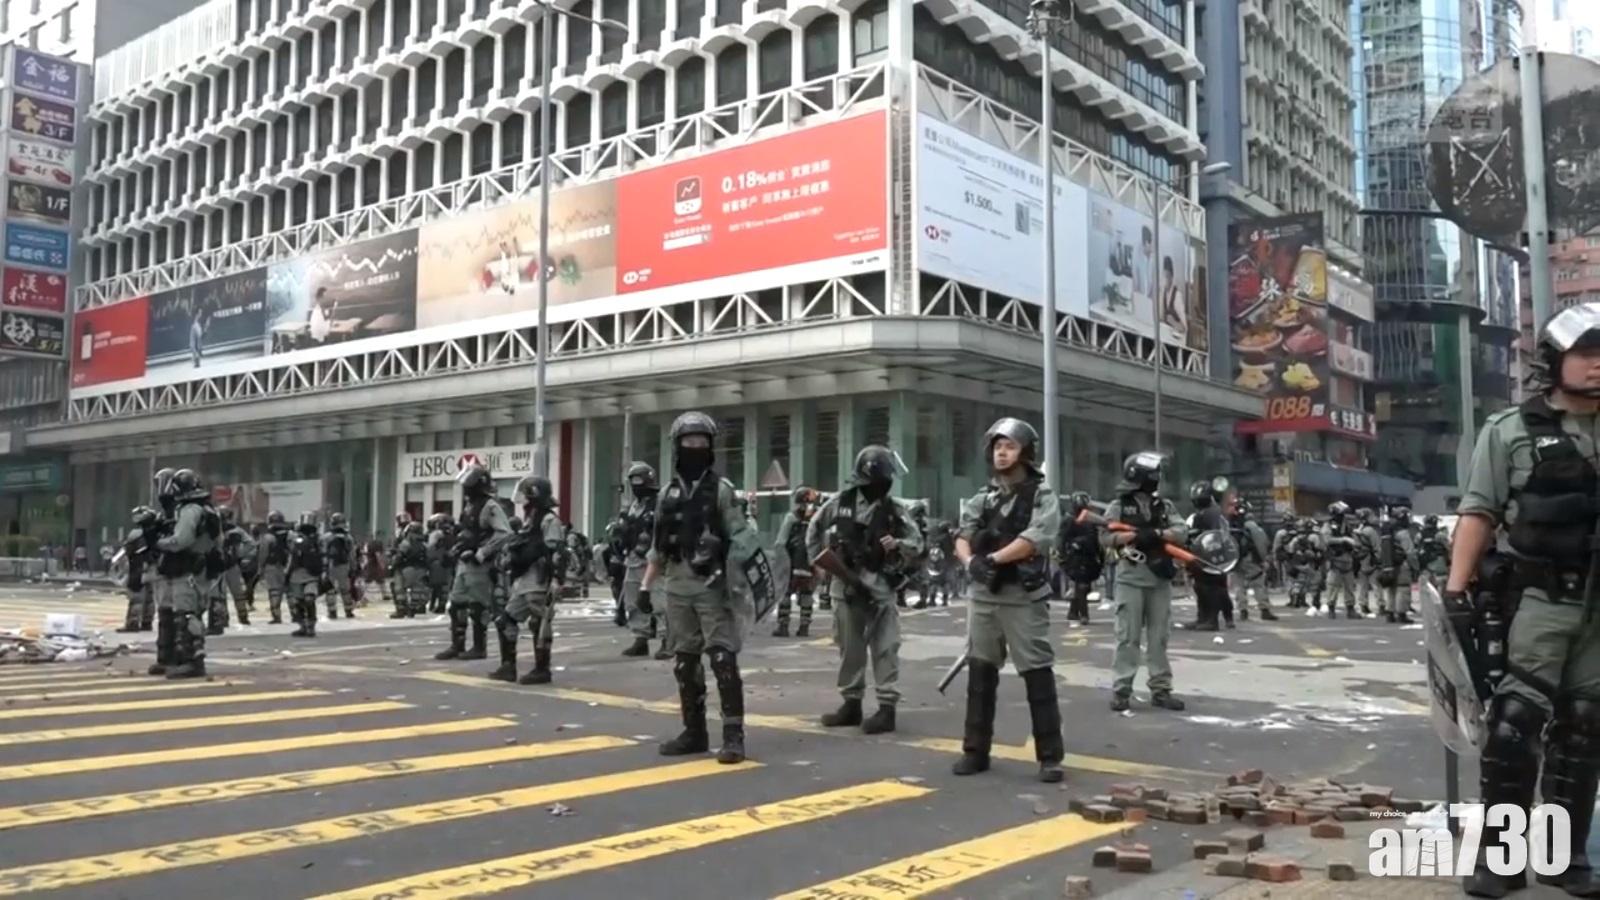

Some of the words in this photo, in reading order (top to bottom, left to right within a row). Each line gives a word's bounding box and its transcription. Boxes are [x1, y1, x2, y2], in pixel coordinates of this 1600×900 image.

[46, 196, 69, 211] 1/F
[964, 190, 993, 212] $1,500
[412, 455, 456, 477] HSBC
